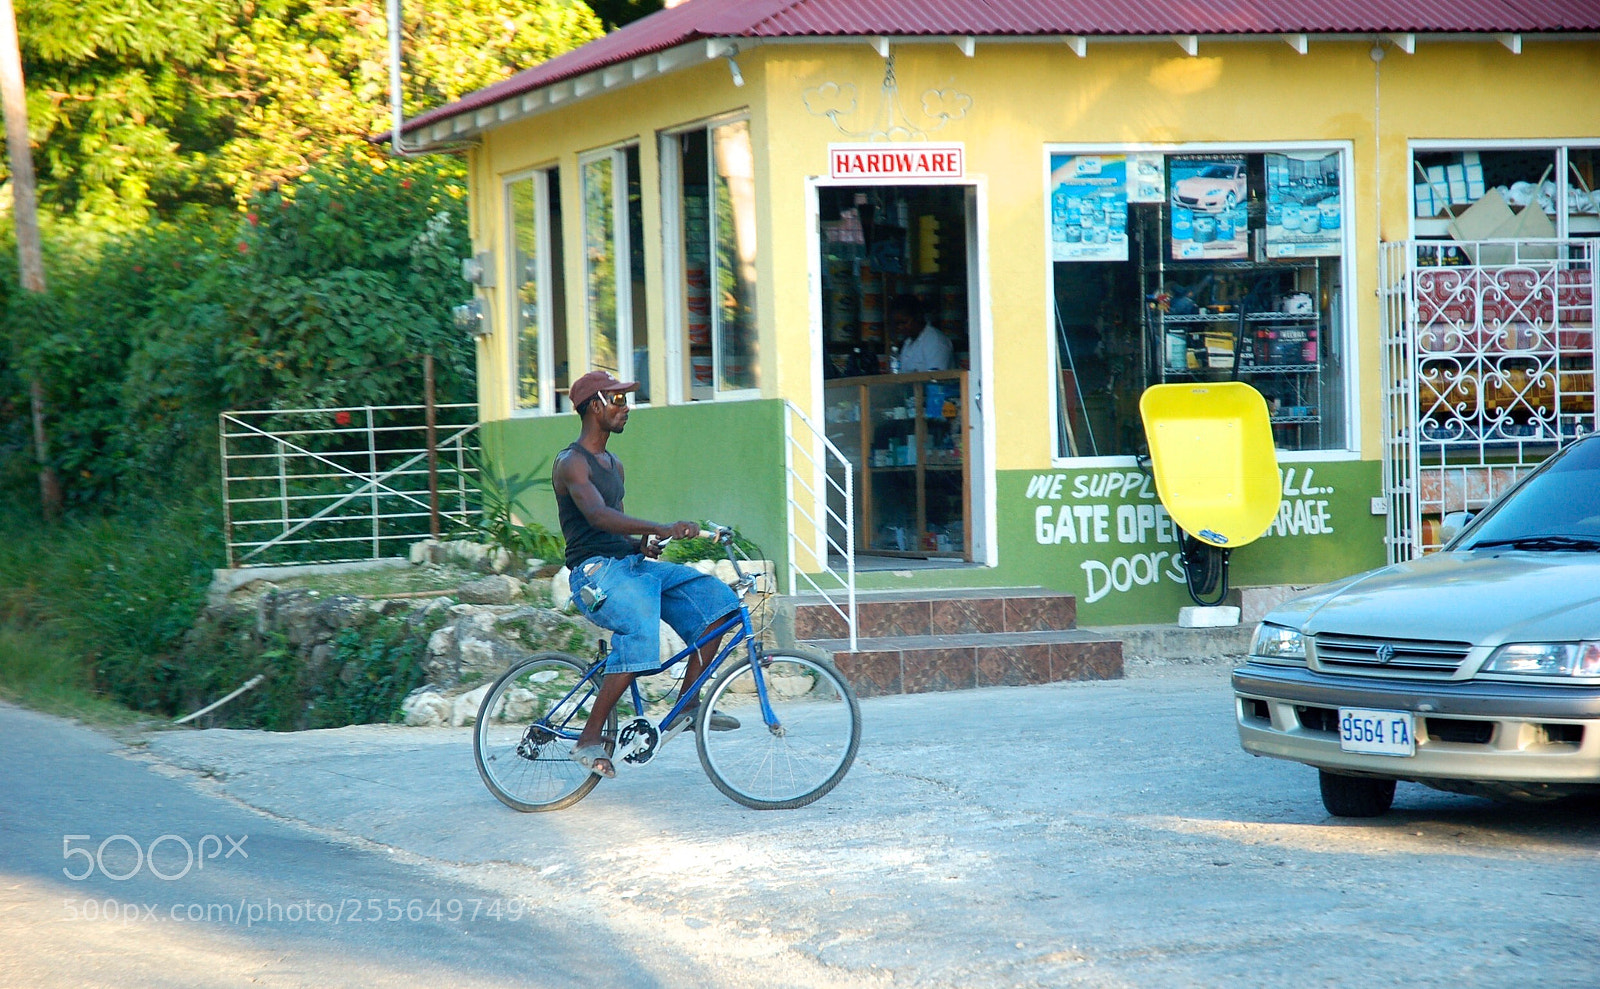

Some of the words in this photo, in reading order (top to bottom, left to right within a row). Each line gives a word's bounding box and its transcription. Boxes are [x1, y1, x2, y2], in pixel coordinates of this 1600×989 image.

[836, 153, 957, 173] HARDWARE
[1025, 473, 1067, 500] WE
[1071, 471, 1158, 499] SUPPL
[1278, 467, 1334, 496] LL..
[1035, 504, 1110, 545] GATE
[1260, 499, 1334, 538] ARAGE
[1342, 718, 1384, 743] 9564
[1392, 720, 1409, 745] FA
